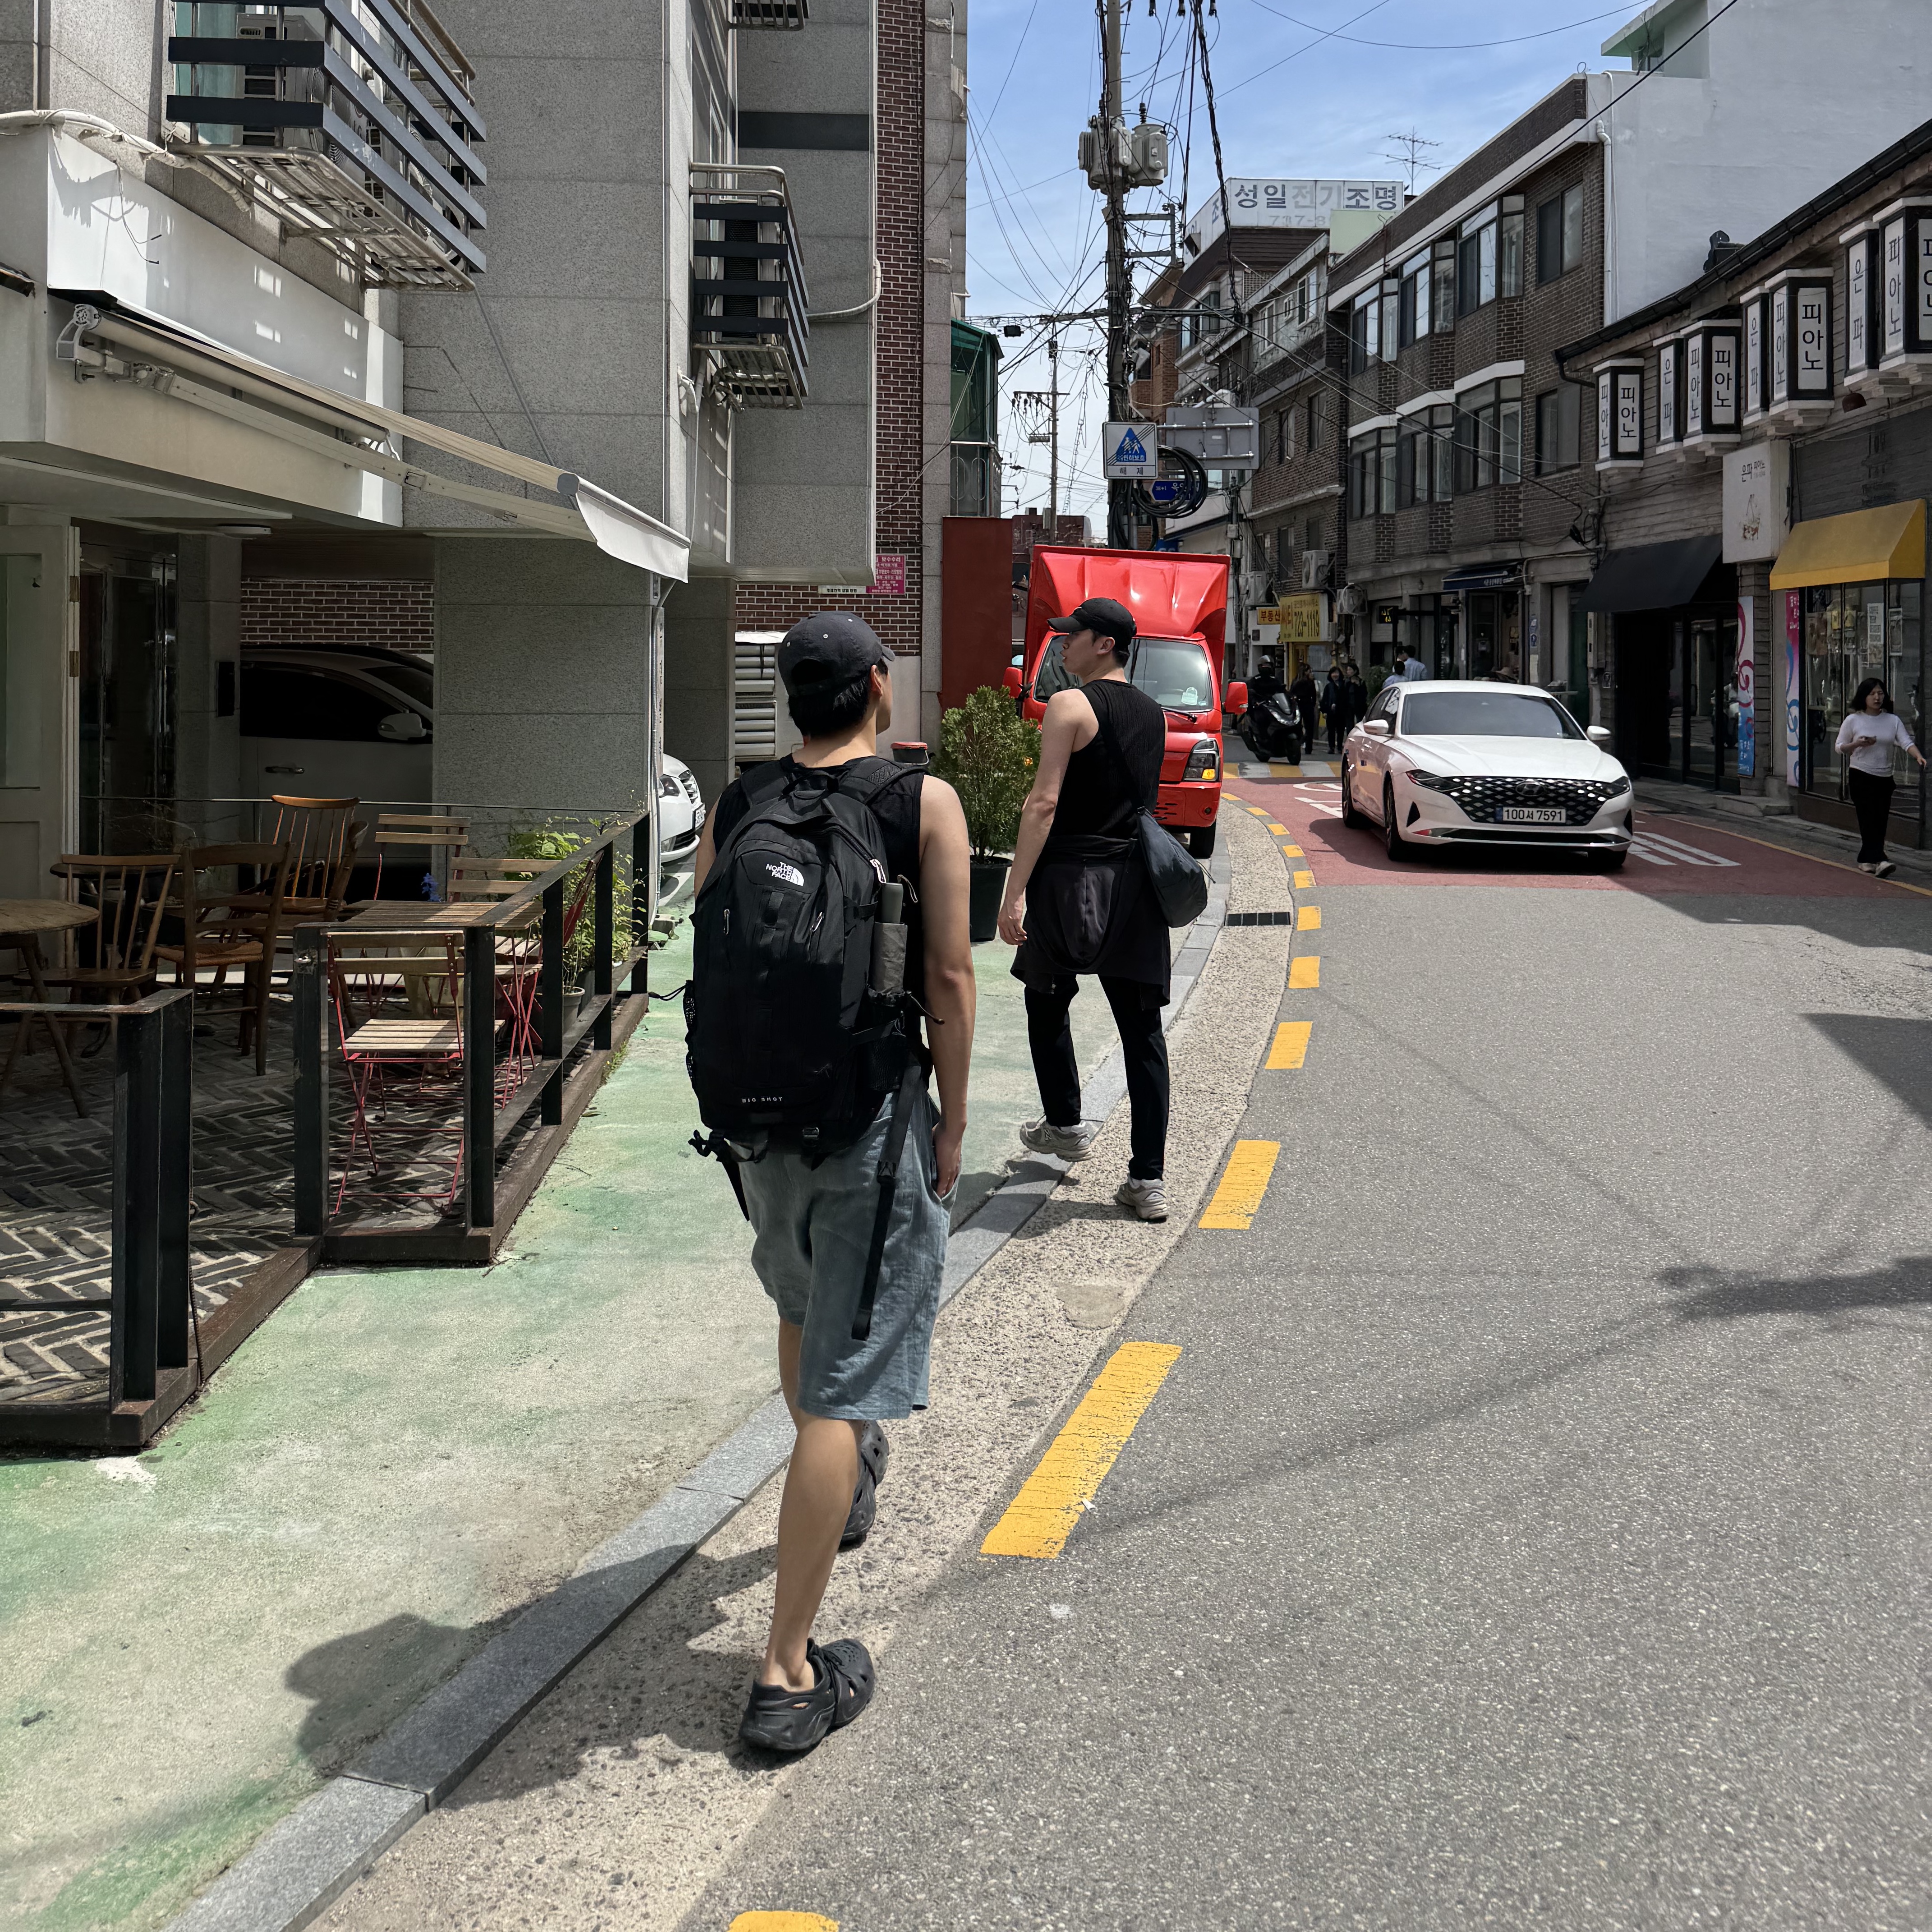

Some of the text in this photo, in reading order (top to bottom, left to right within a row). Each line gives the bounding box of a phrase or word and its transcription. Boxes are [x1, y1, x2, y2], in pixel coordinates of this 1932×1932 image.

[1853, 259, 1863, 349] 은파
[1889, 236, 1901, 336] 피아노
[1751, 317, 1758, 393] 은파
[1777, 301, 1785, 385] 피아노
[1802, 304, 1823, 370] 피아노
[1664, 358, 1671, 426] 은파
[1691, 347, 1700, 420] 피아노
[1715, 350, 1731, 407] 피아노
[1621, 387, 1637, 438] 피아노
[1742, 463, 1752, 482] 은파
[1754, 460, 1765, 470] 피아노
[1261, 610, 1280, 622] 부동산
[1505, 809, 1562, 821] 100서 7591
[765, 864, 793, 877] NORTH
[771, 871, 790, 881] FACE
[780, 861, 793, 870] THE
